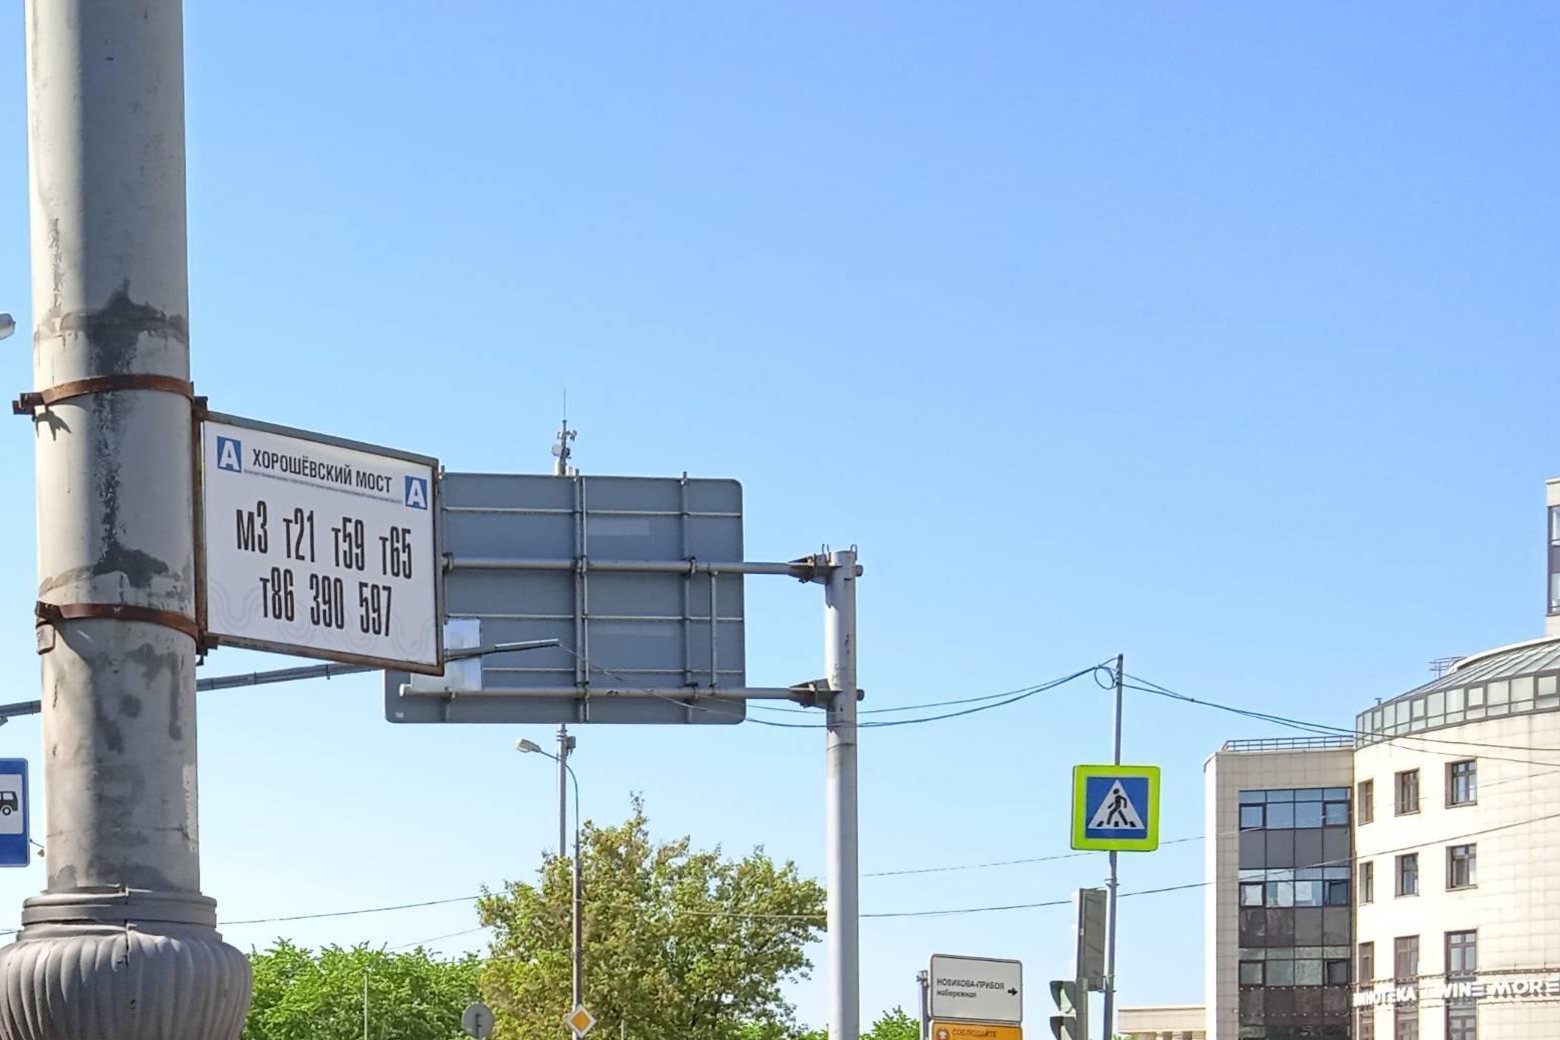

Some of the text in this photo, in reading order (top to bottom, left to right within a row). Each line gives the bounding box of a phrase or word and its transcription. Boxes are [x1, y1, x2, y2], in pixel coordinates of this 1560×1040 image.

[252, 448, 353, 487] ХОРОШЁВСКИЙ
[355, 471, 392, 493] МОСТ
[283, 507, 316, 562] т21
[332, 516, 365, 571] т59
[379, 526, 412, 579] т65
[259, 567, 392, 637] т86 390 597
